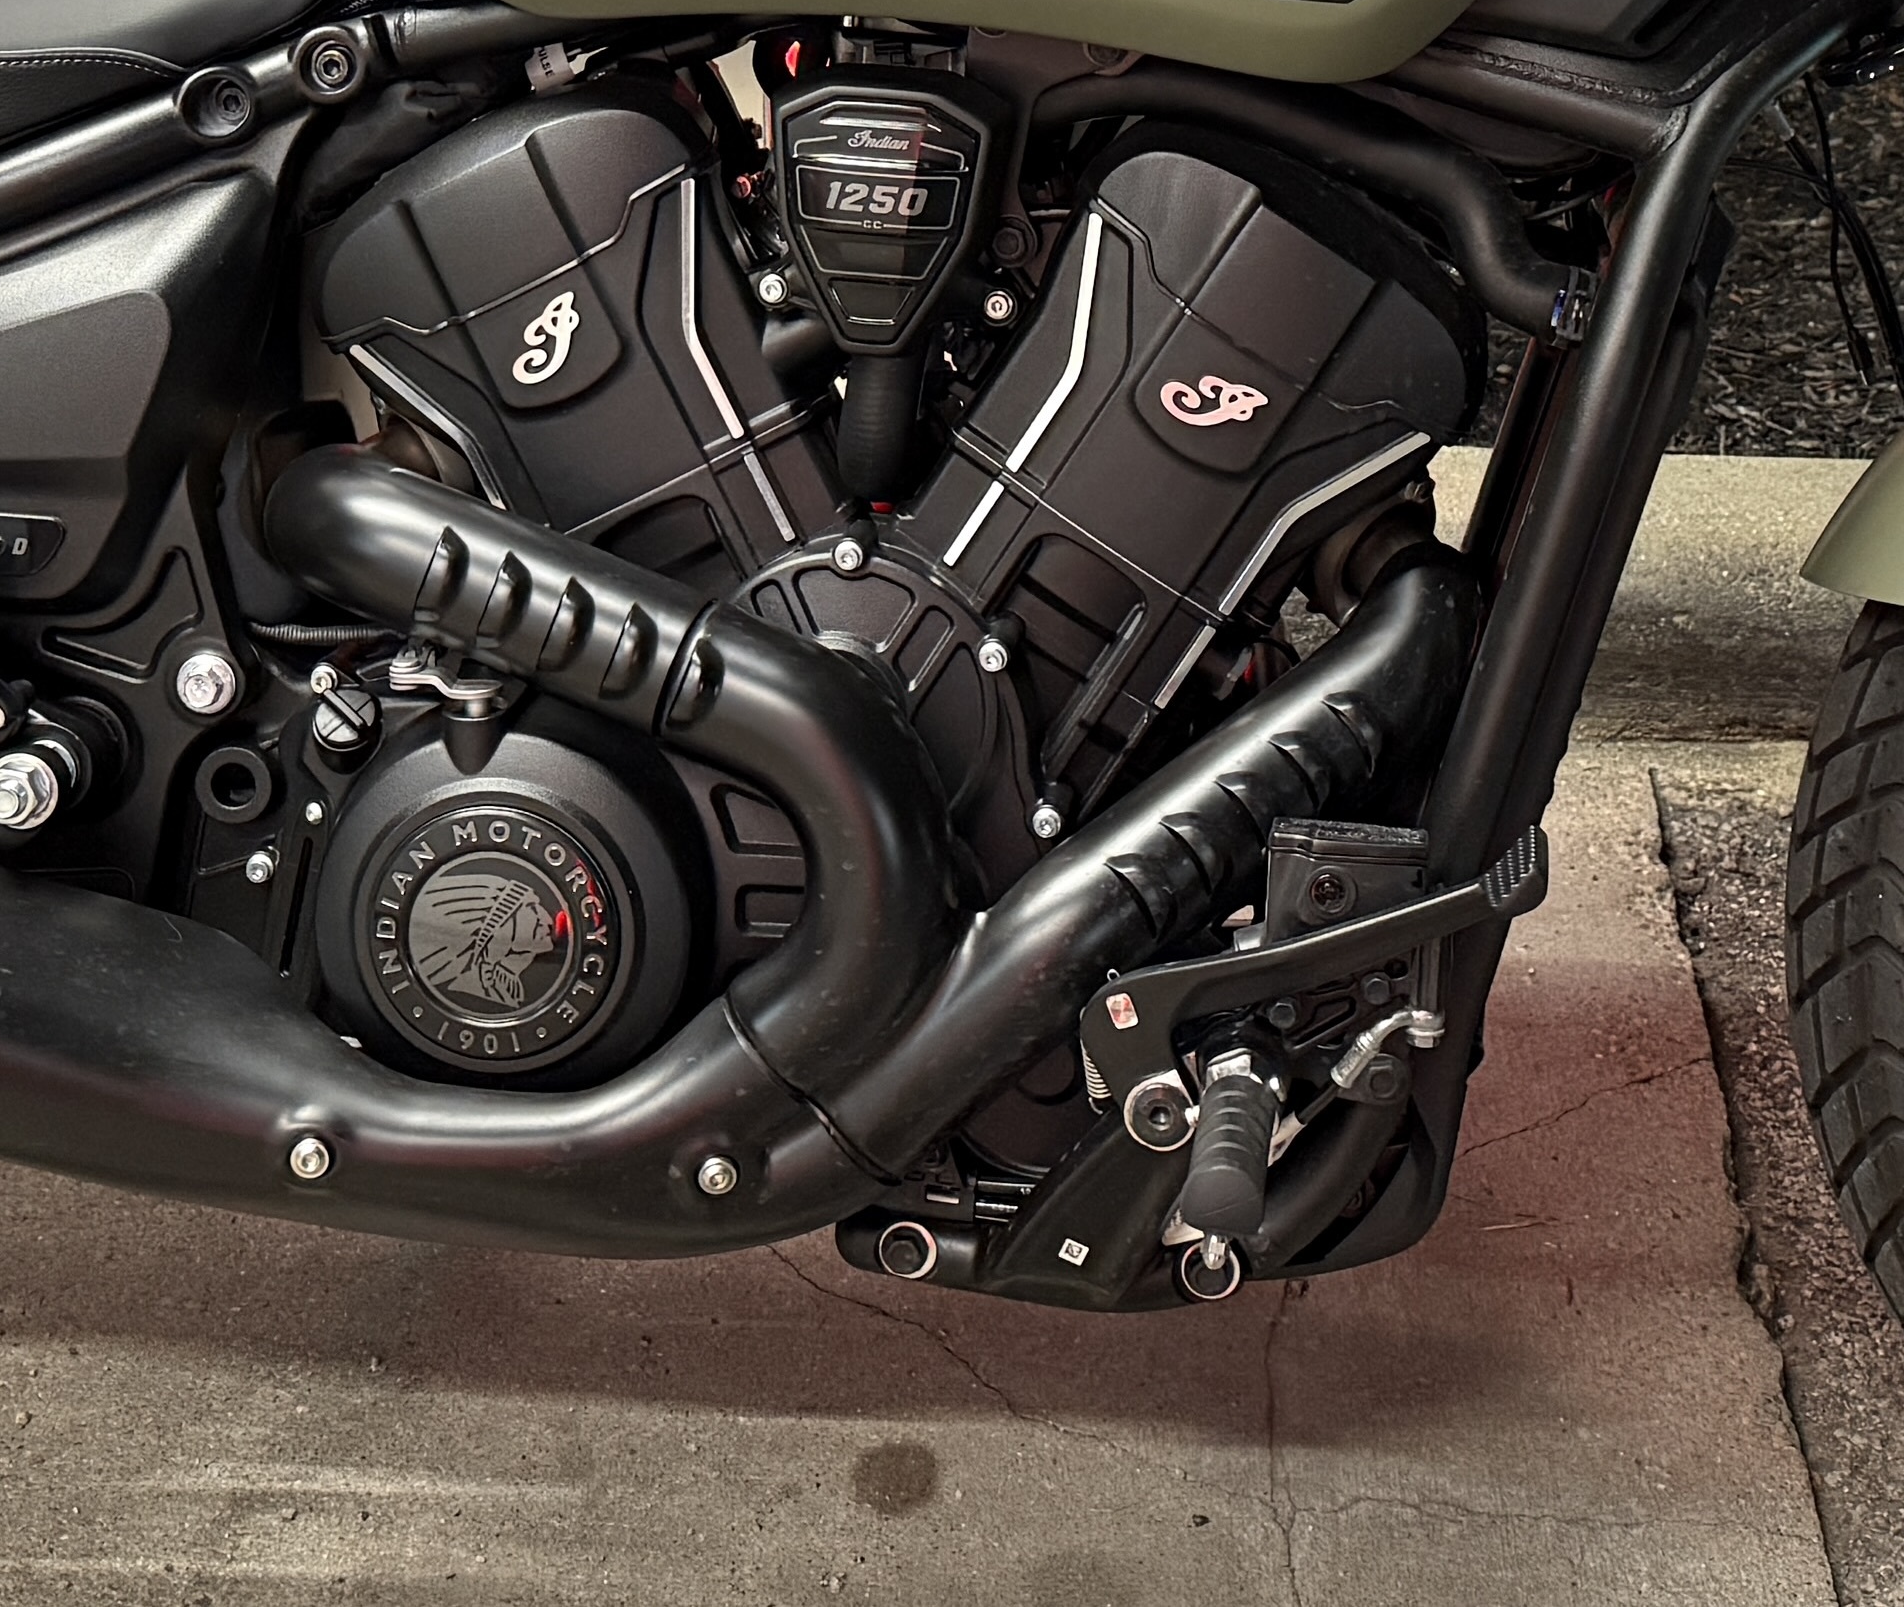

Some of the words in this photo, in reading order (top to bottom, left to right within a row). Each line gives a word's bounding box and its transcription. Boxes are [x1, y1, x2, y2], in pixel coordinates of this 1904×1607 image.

[847, 129, 911, 151] Indian
[825, 180, 929, 217] 1250
[862, 219, 883, 230] CC
[375, 840, 437, 995] INDIAN
[450, 819, 609, 1024] MOTORCYCLE
[436, 1020, 522, 1055] 1901
